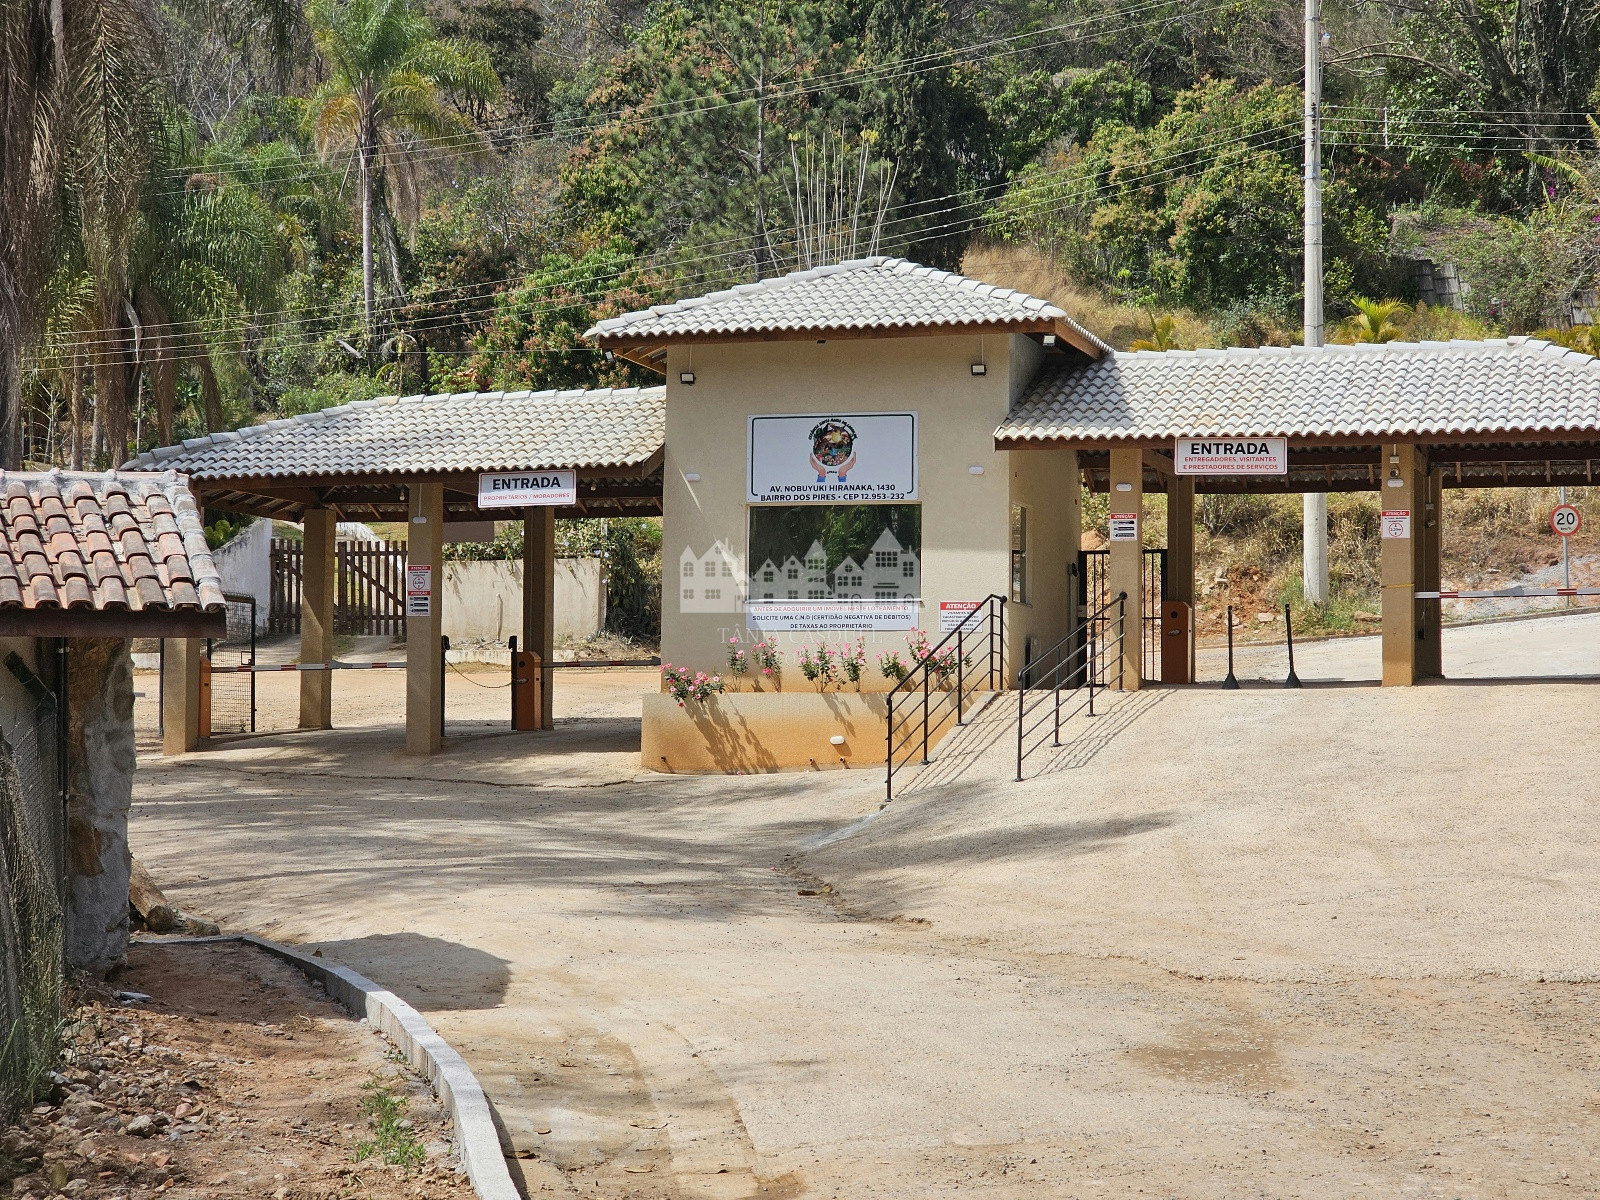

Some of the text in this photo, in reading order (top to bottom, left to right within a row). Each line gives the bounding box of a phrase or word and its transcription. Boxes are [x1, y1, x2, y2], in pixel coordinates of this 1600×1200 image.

[1190, 442, 1270, 455] ENTRADA
[492, 476, 561, 490] ENTRADA
[829, 484, 875, 492] HIRANAKA,
[483, 493, 528, 501] PROPRIETÁRIOS
[812, 493, 836, 501] PIRES
[860, 492, 905, 500] 12.953-232
[1556, 512, 1575, 525] 20
